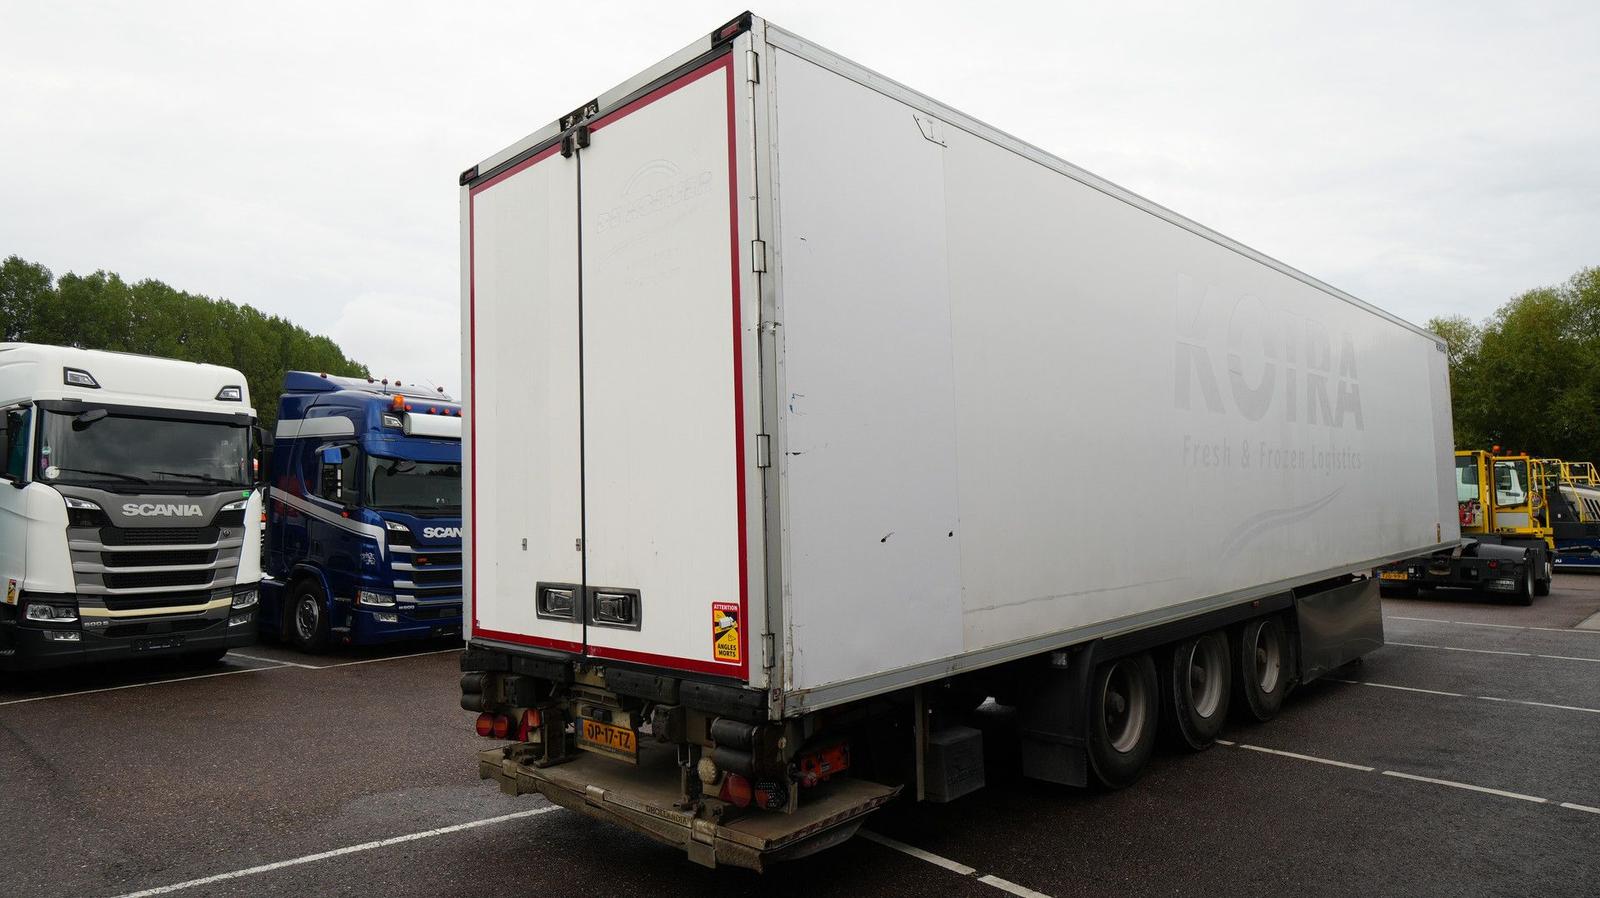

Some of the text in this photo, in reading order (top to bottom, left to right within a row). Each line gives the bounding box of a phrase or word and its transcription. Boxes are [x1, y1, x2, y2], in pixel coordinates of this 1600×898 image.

[1174, 271, 1364, 432] KOTRA
[1182, 433, 1361, 476] Fresh & Frozen Logistics
[122, 503, 203, 517] SCANIA
[717, 643, 737, 651] ANGLES
[718, 650, 736, 658] MORTS
